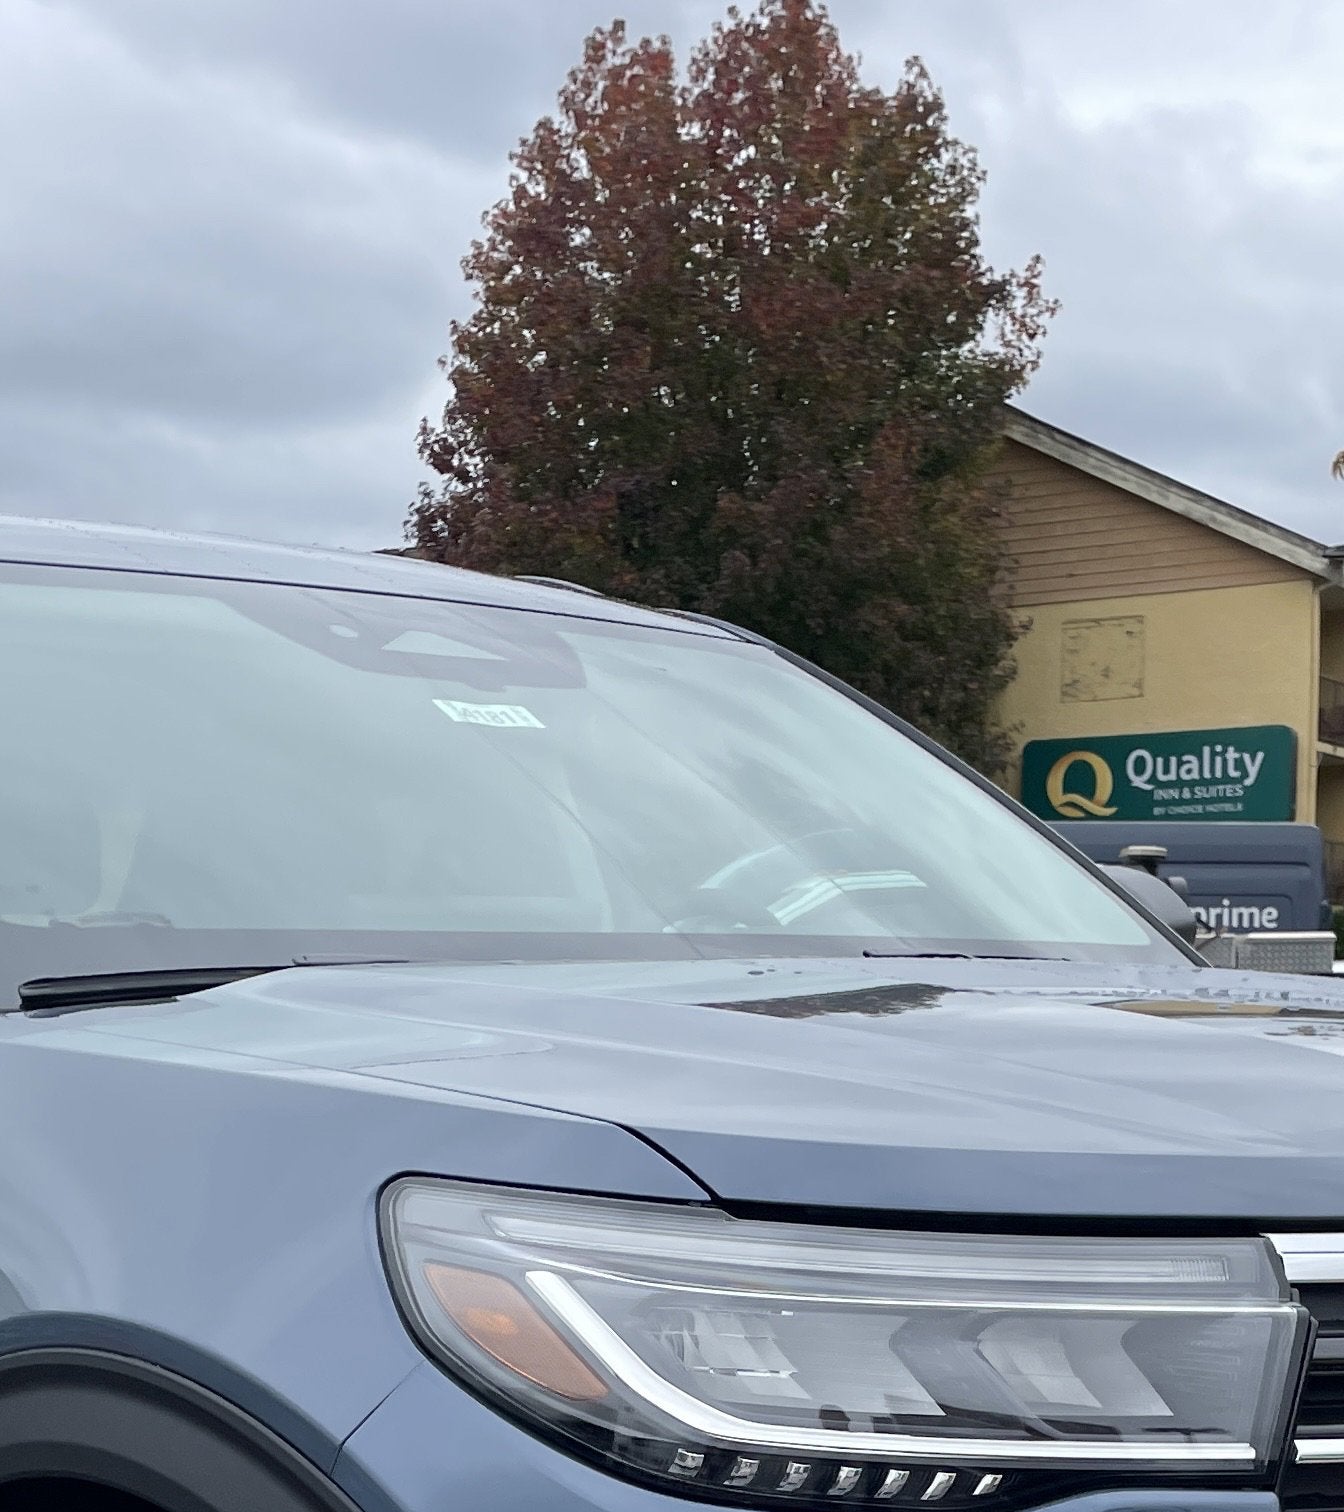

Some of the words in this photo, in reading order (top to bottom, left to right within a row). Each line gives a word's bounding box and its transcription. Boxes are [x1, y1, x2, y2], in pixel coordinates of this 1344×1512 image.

[1045, 750, 1119, 818] Q
[1125, 744, 1265, 791] Quality
[1153, 788, 1179, 800] INN
[1181, 787, 1191, 799] &
[1193, 784, 1244, 799] SUITES
